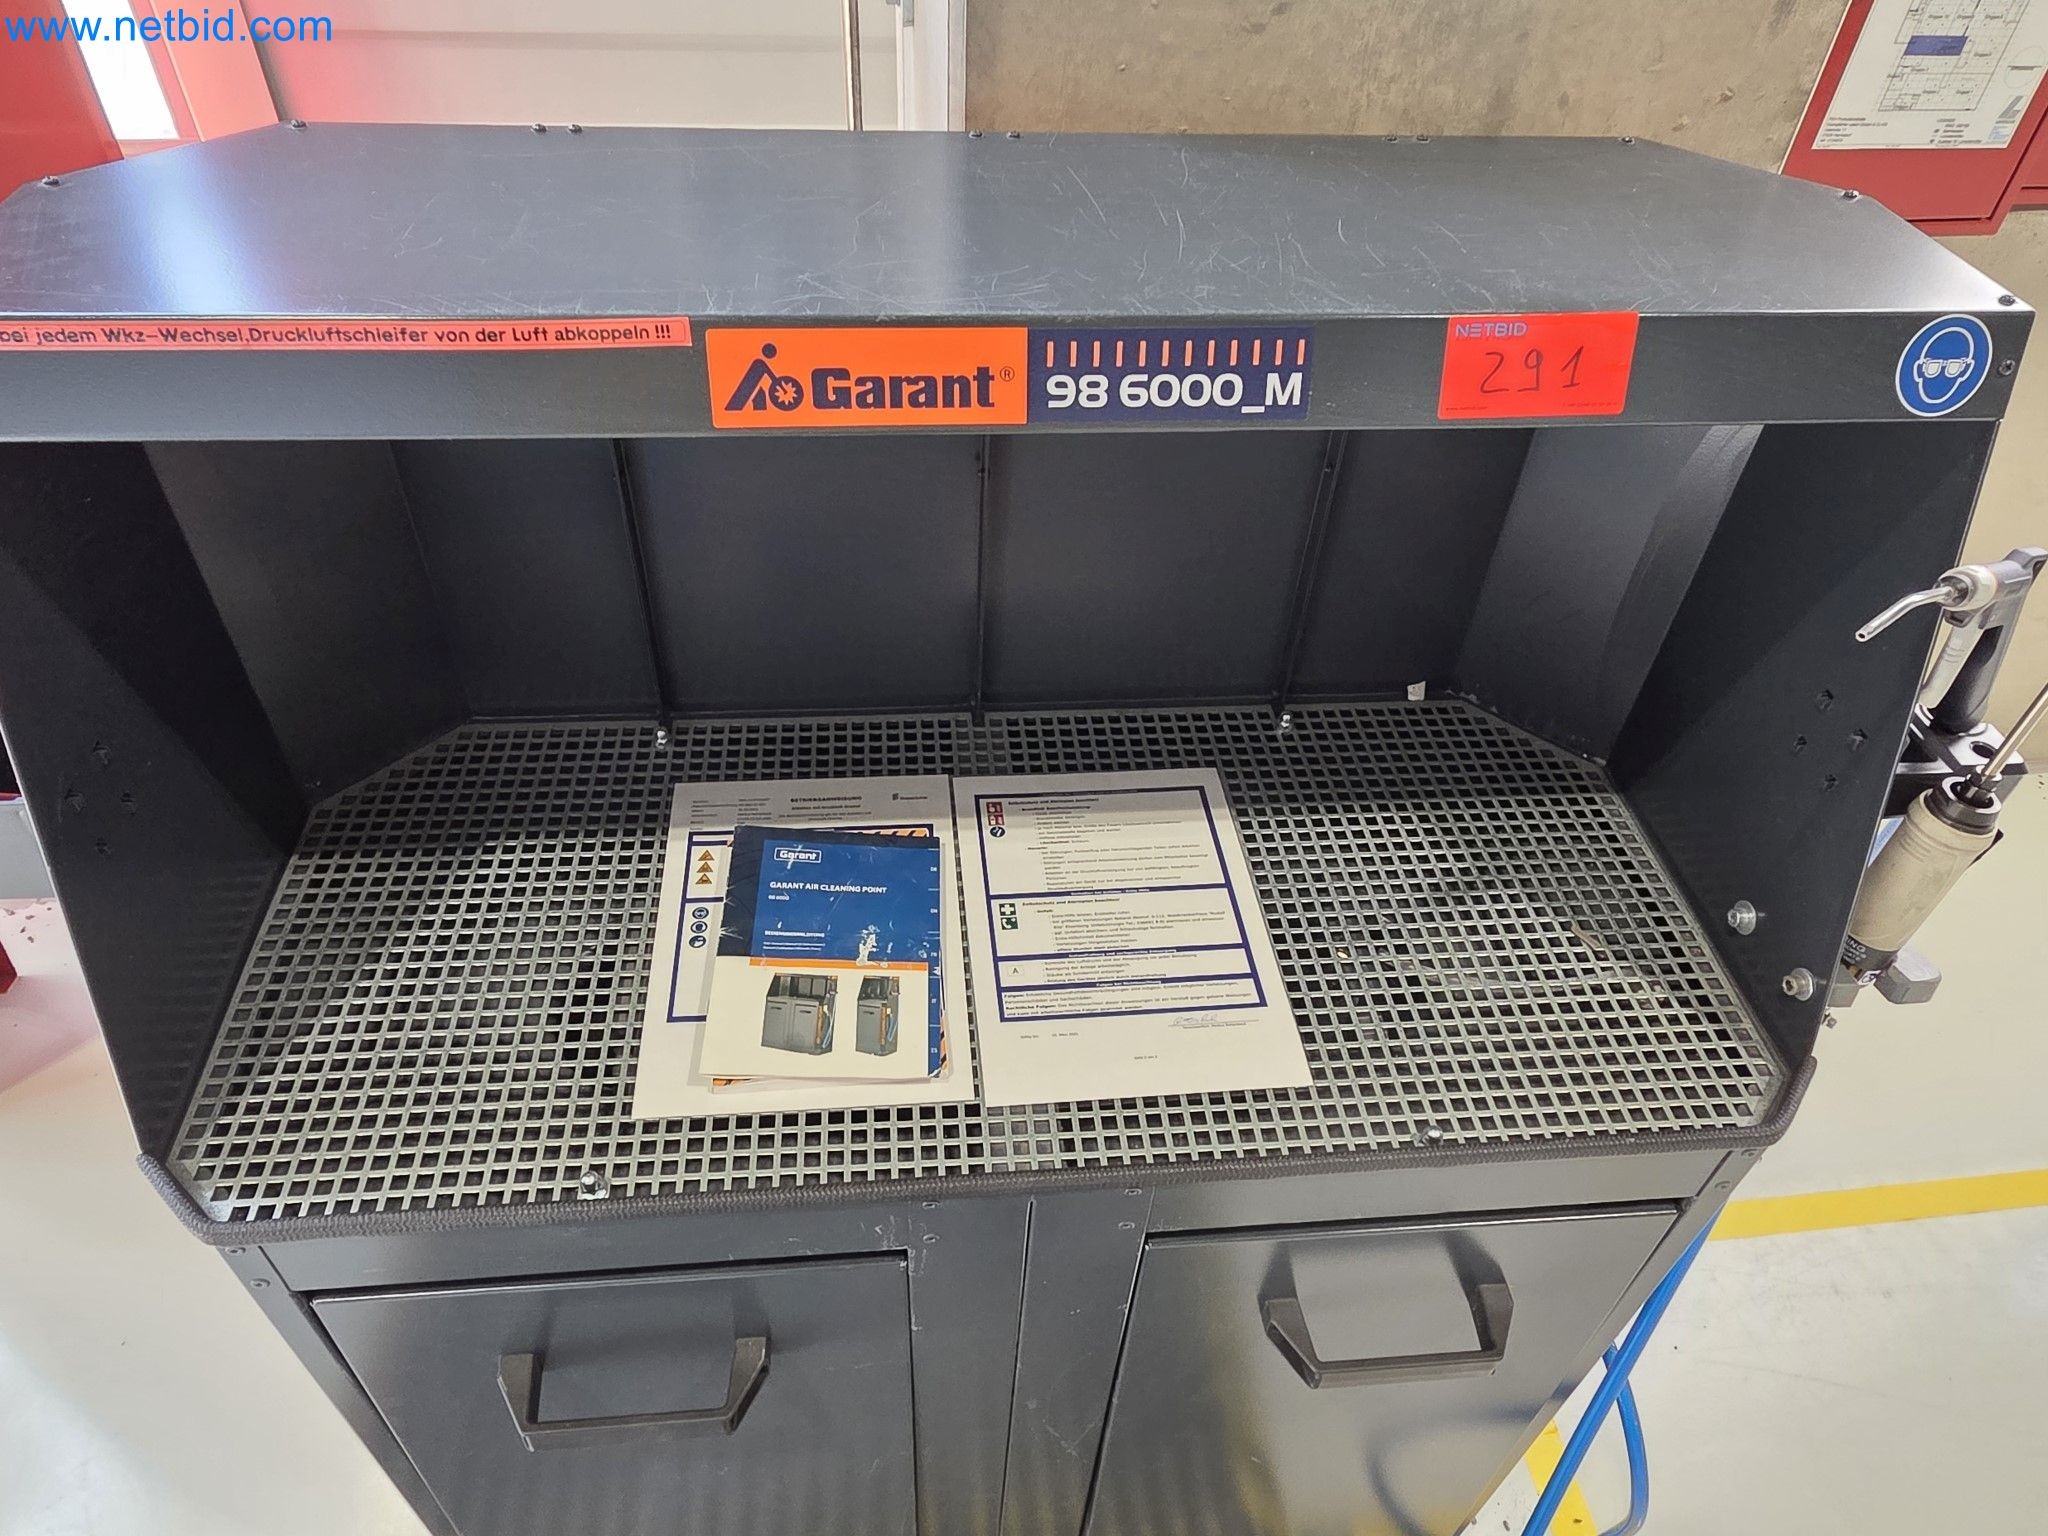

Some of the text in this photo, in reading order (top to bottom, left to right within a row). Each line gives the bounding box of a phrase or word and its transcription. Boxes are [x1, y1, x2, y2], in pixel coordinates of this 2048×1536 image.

[36, 326, 97, 345] jedem
[434, 328, 467, 342] von
[475, 325, 506, 343] der
[512, 325, 548, 342] Luft
[555, 324, 649, 344] abkoppeln
[1455, 322, 1528, 337] NETBID
[1047, 372, 1303, 413] 98 6000_M
[779, 850, 817, 860] Garant
[769, 881, 888, 894] GARANT AIR CLEANING POINT
